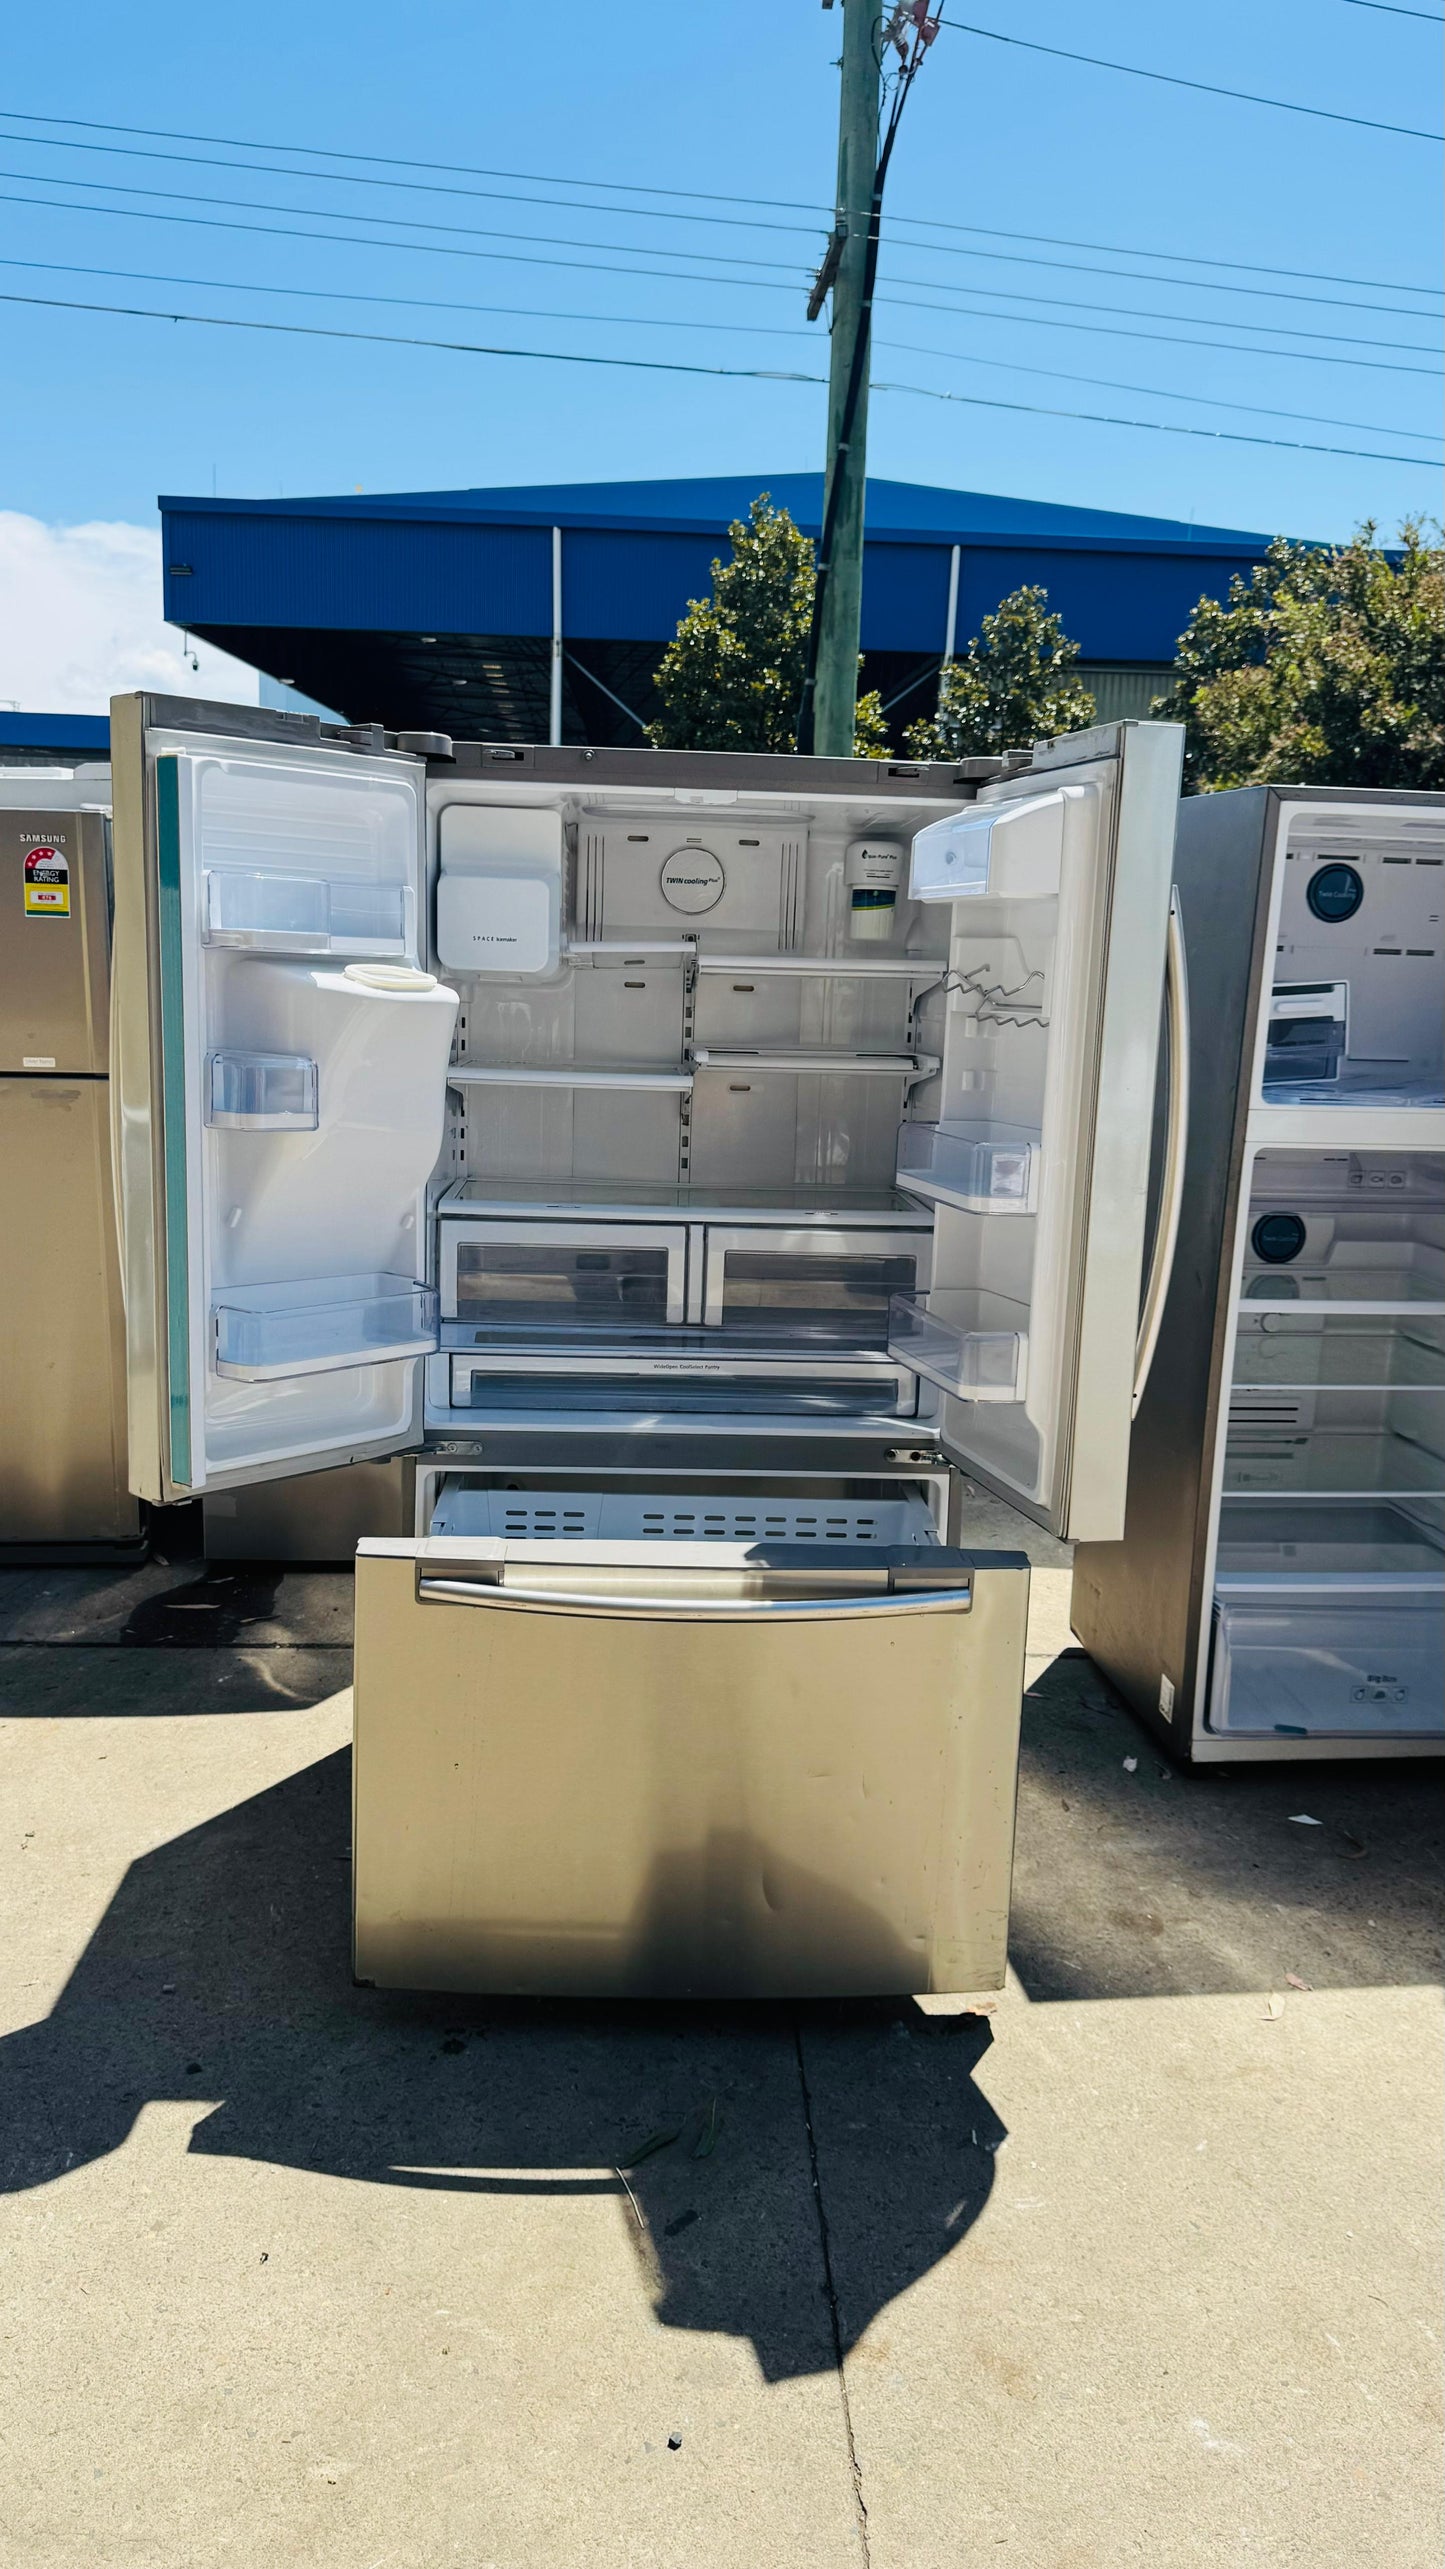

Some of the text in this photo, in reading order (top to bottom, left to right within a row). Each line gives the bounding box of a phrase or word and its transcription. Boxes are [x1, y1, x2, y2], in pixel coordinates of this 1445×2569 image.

[19, 833, 67, 843] SAMSUNG
[33, 869, 60, 877] ENERGY
[684, 877, 708, 886] cooling
